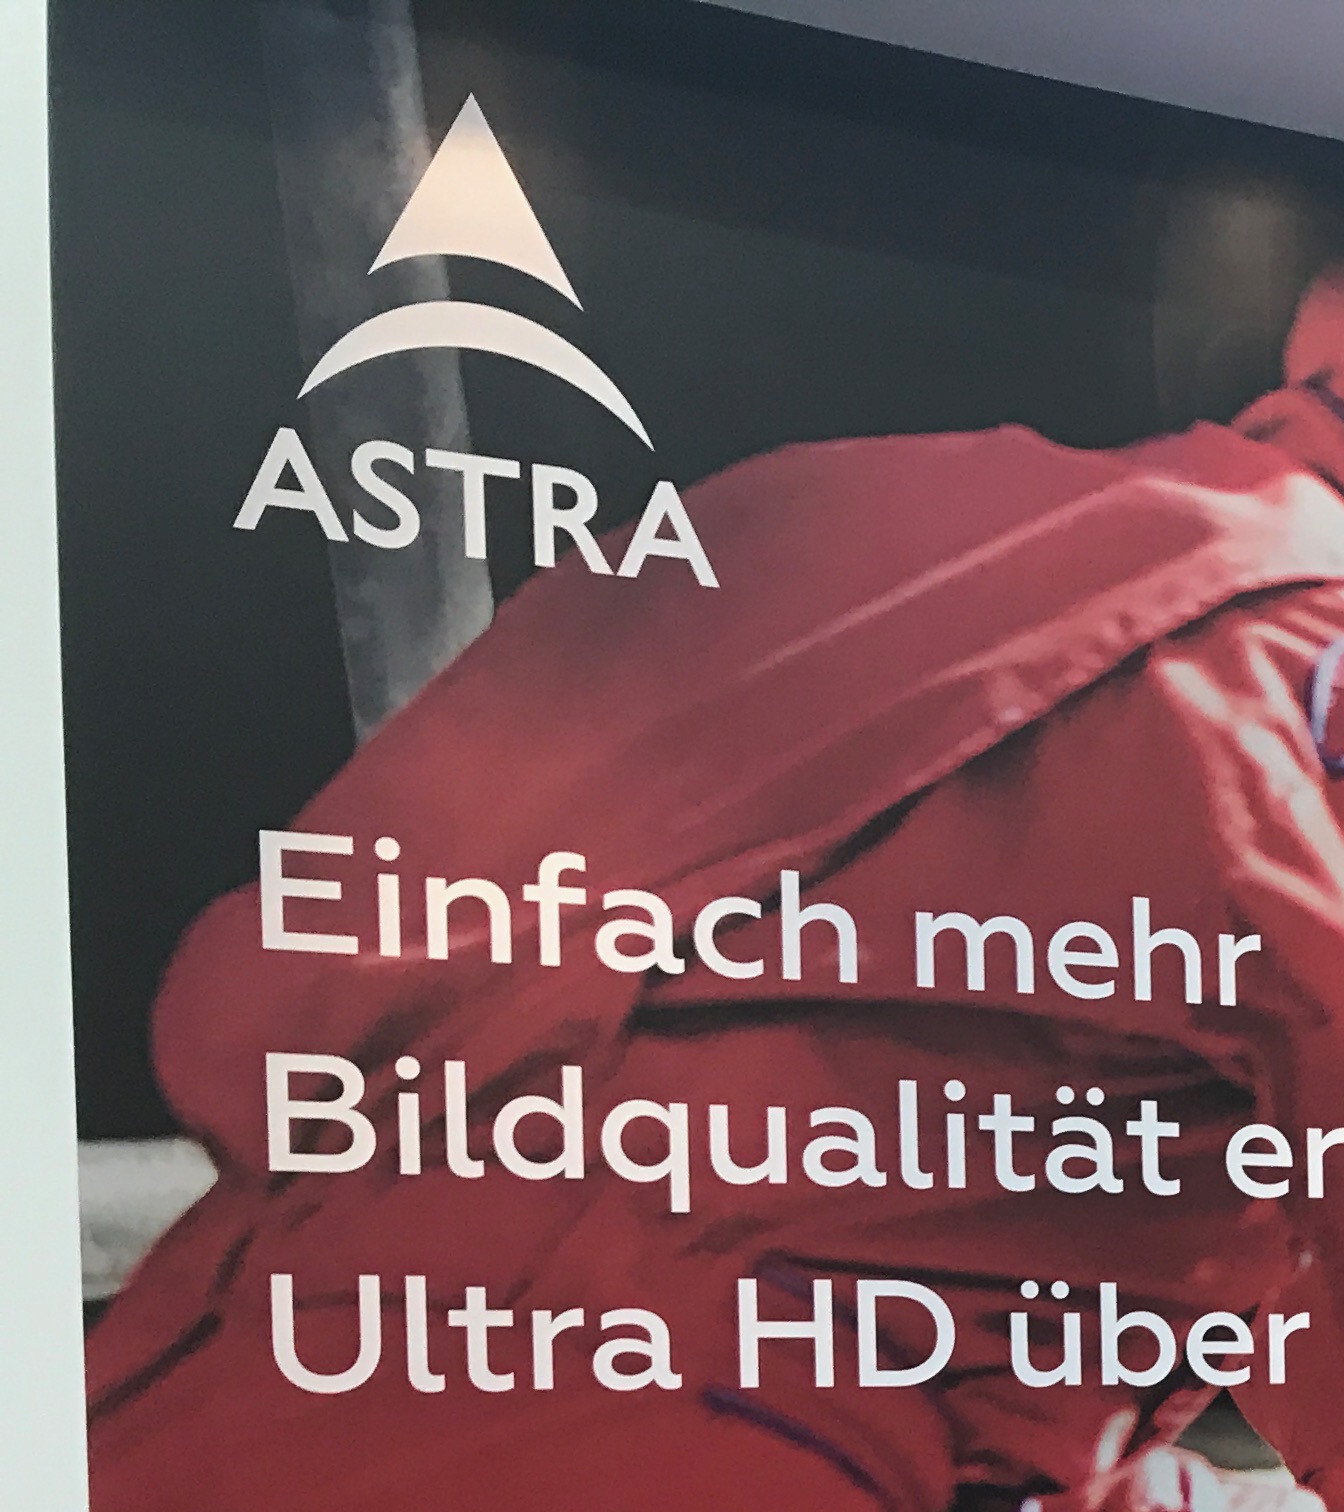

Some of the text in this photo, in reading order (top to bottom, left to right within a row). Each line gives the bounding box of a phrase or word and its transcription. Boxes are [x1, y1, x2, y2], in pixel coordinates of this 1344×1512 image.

[232, 427, 720, 588] ASTRA
[258, 829, 1261, 1007] Einfach mehr
[265, 1052, 1181, 1214] Bildqualität
[270, 1273, 683, 1394] Ultra
[738, 1278, 956, 1389] HD
[1010, 1280, 1311, 1388] über
